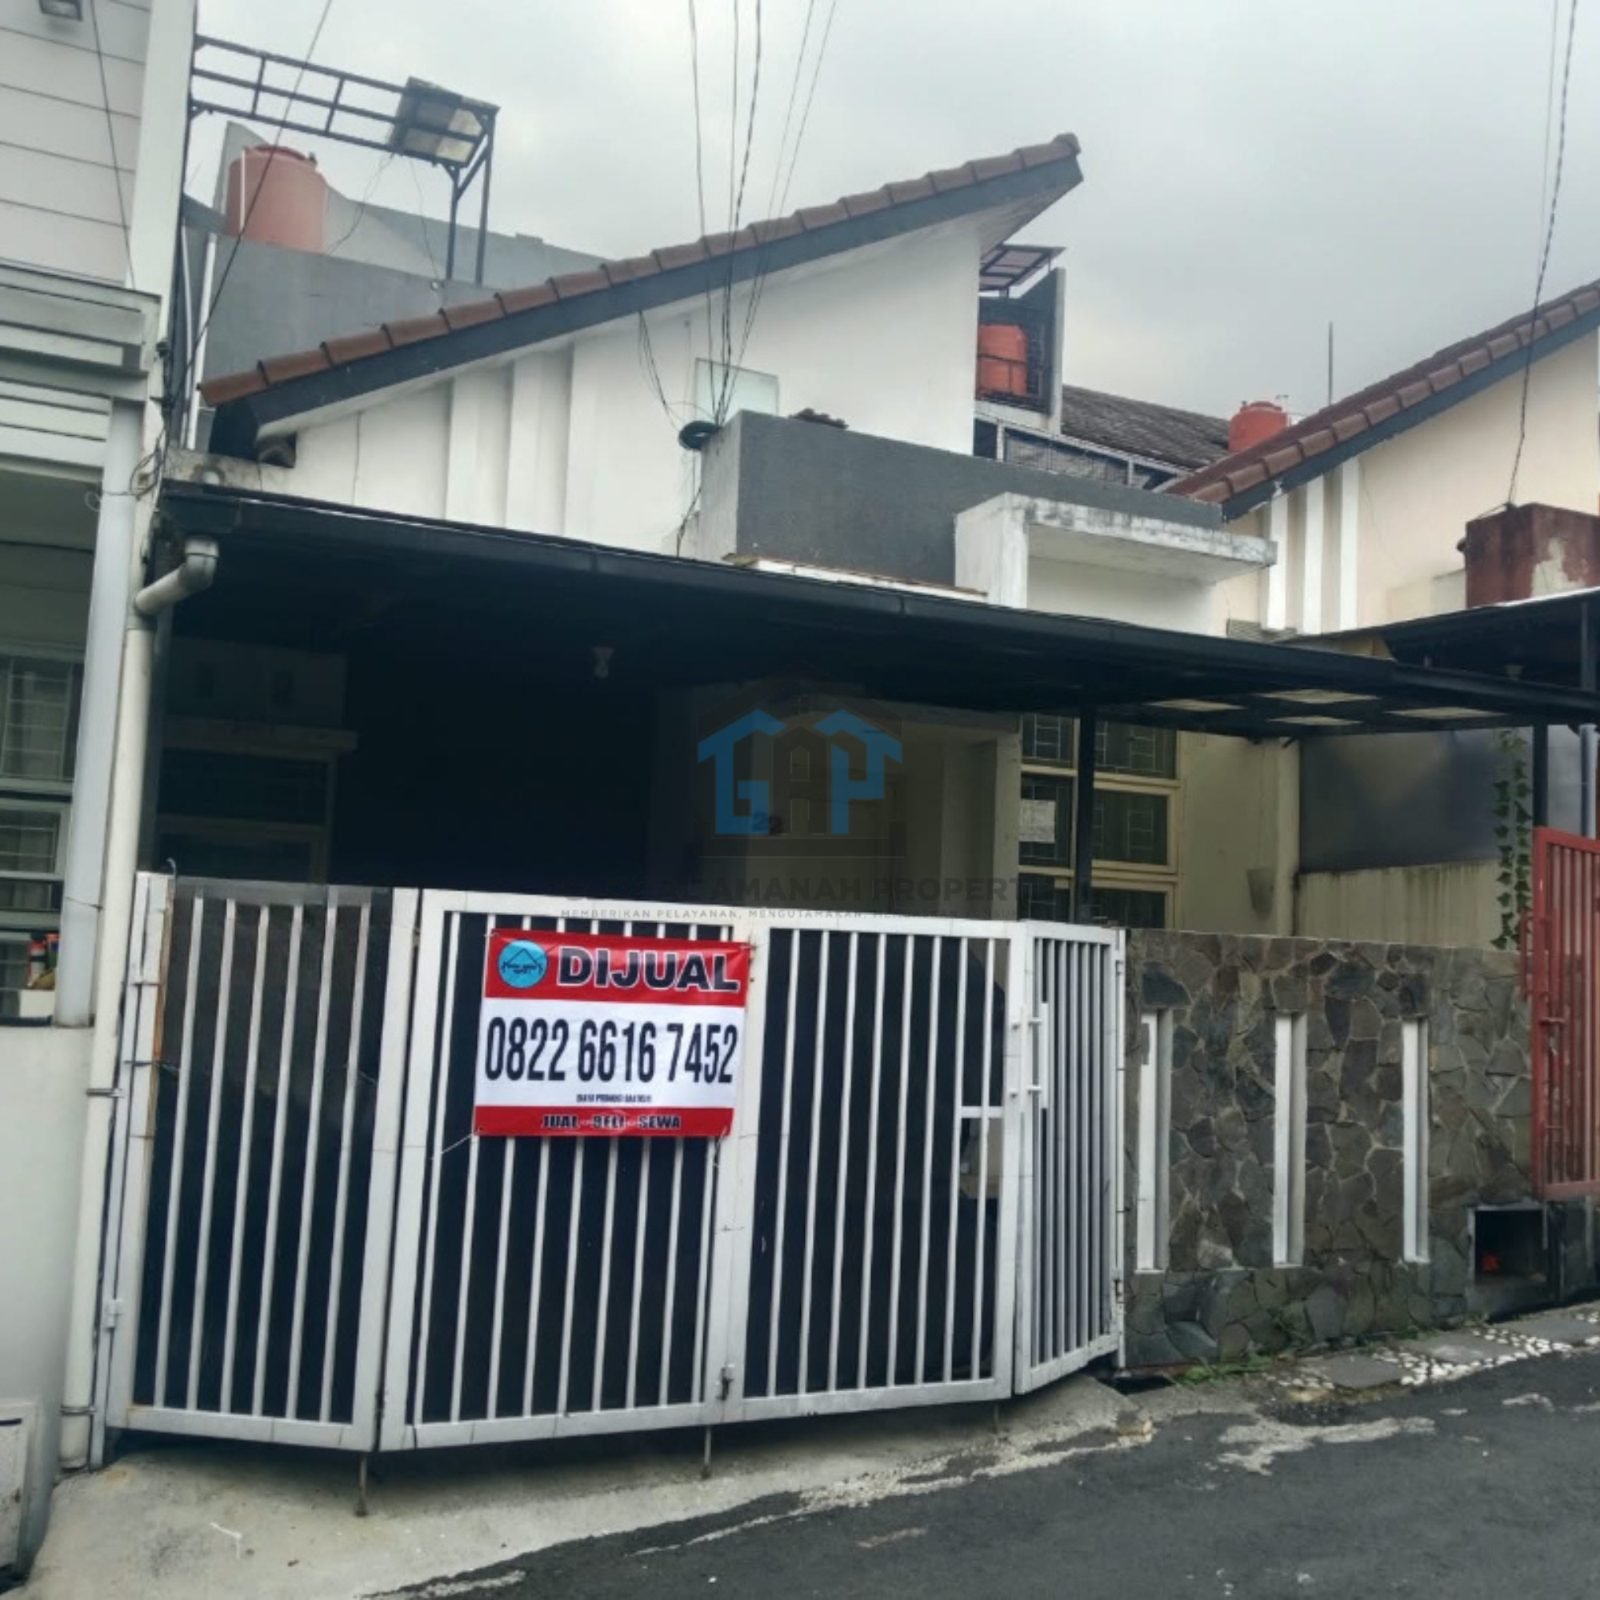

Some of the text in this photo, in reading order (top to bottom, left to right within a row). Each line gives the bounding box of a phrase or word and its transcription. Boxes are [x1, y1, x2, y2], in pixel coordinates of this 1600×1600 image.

[556, 945, 740, 993] DIJUAL
[485, 1016, 738, 1084] 0822 6616 7452
[541, 1114, 578, 1129] JUAL
[638, 1115, 681, 1130] SEWA
